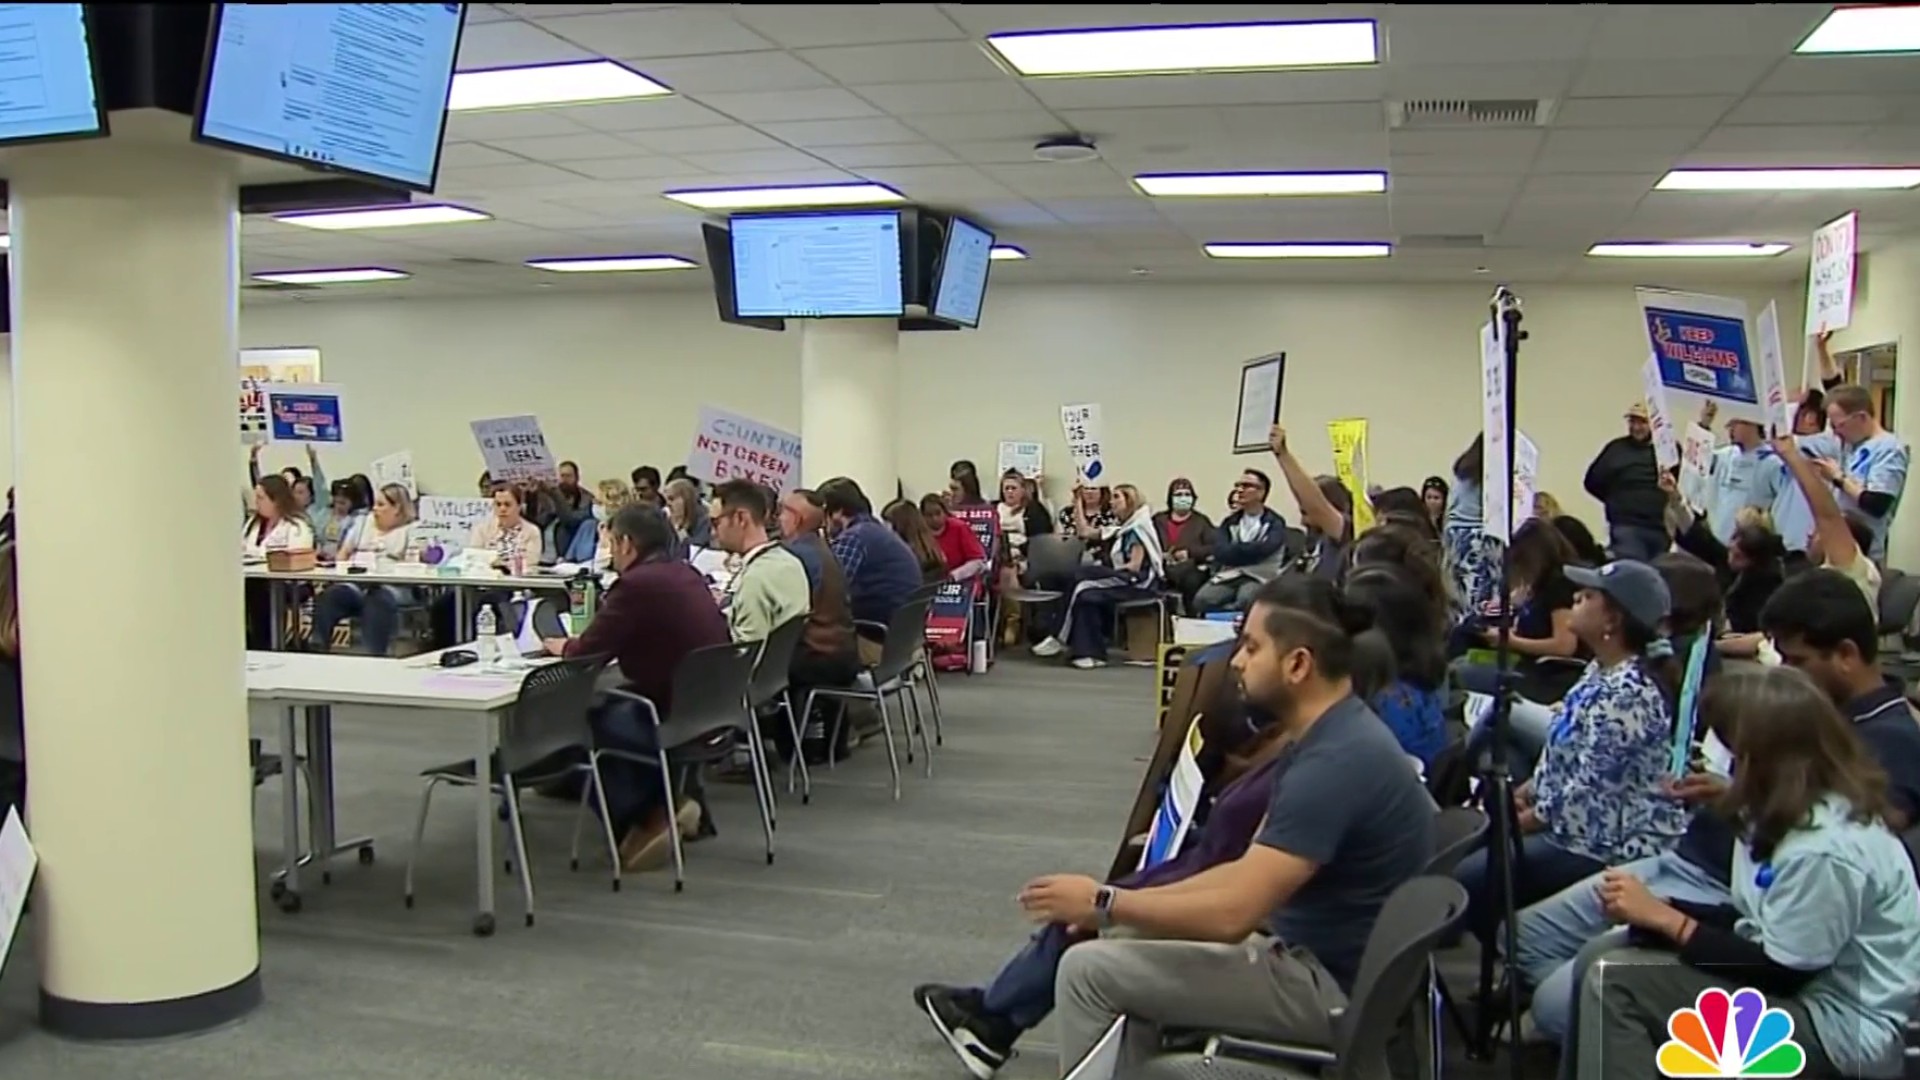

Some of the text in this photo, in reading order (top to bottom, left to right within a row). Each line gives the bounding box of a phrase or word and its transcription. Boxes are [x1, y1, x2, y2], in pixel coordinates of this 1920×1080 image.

[1678, 325, 1715, 344] KEEP
[1663, 340, 1740, 371] WILLIAMS
[711, 418, 777, 449] COUNT
[696, 433, 790, 475] NOT GREEN
[714, 459, 784, 493] BOXES
